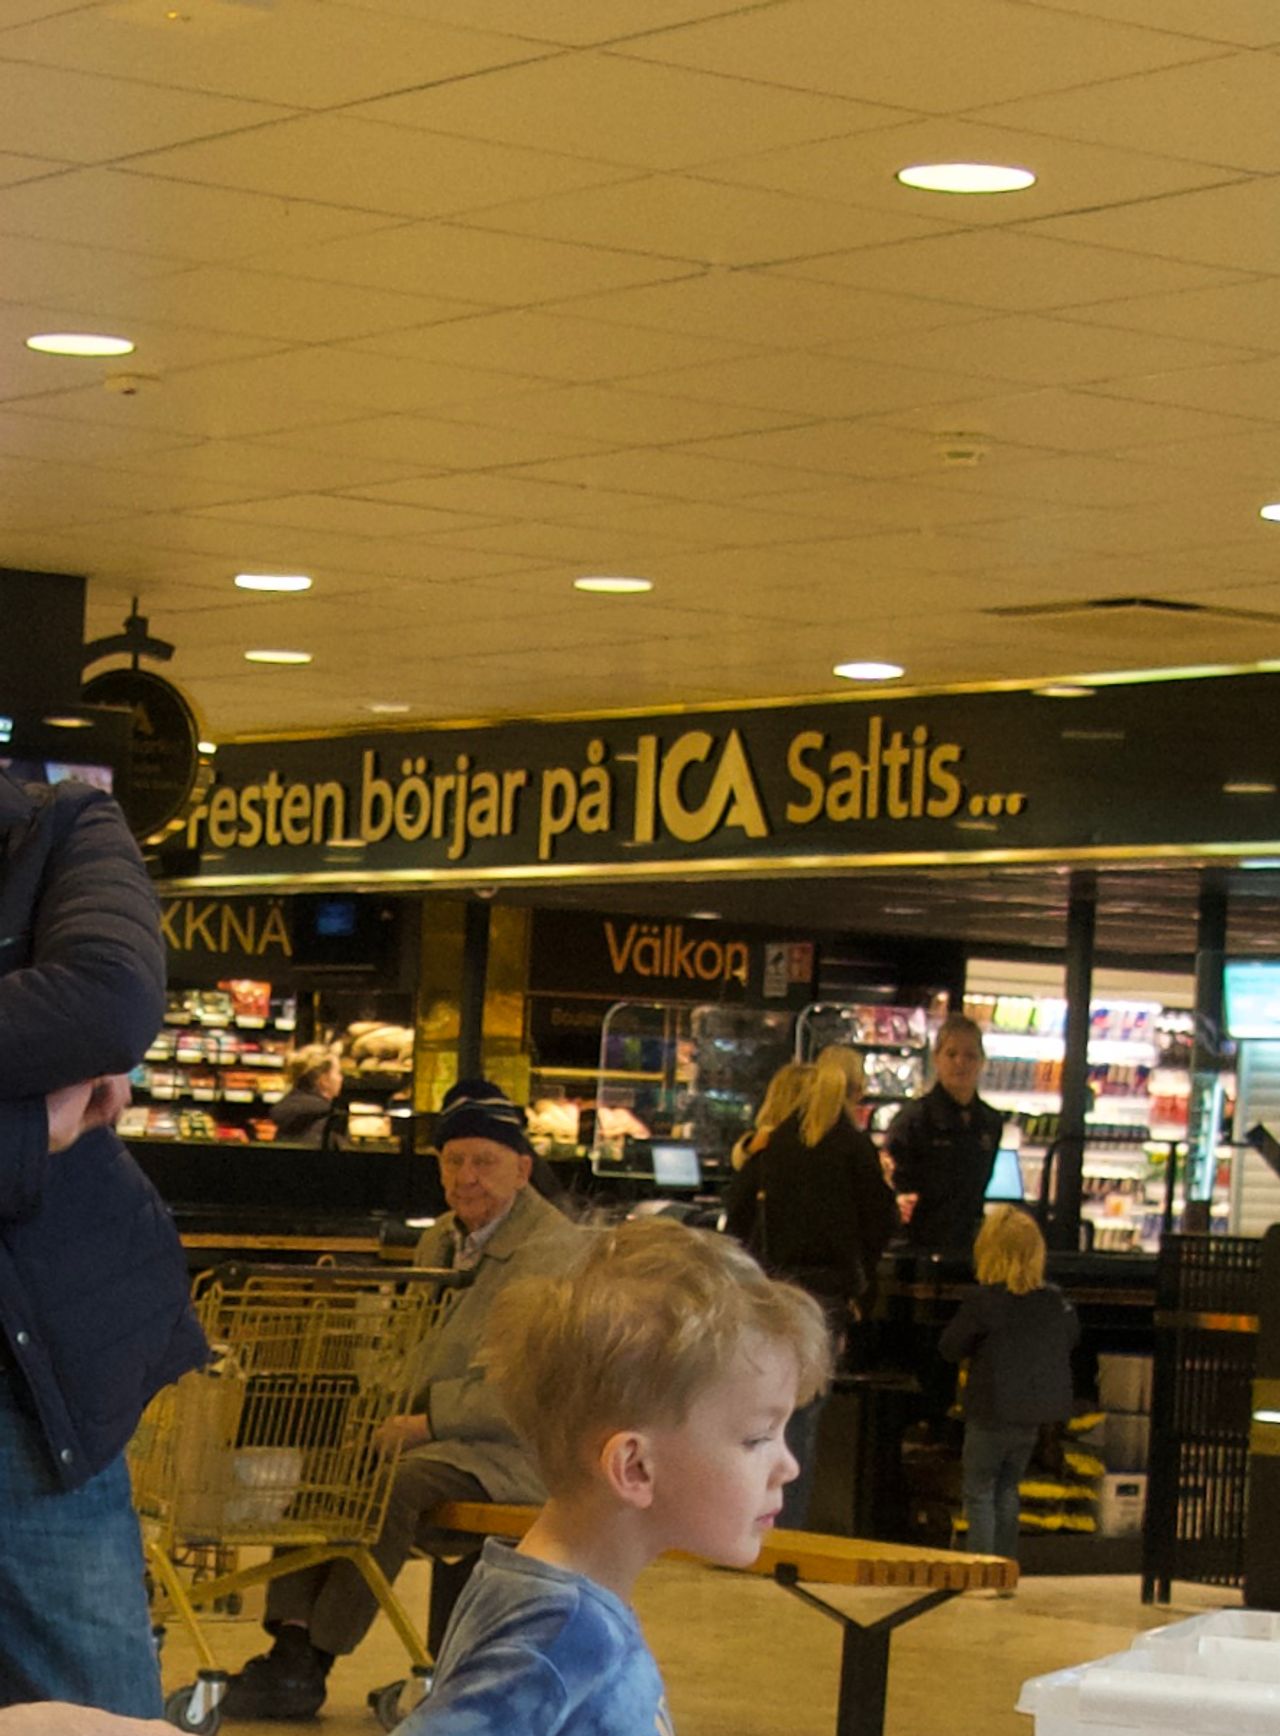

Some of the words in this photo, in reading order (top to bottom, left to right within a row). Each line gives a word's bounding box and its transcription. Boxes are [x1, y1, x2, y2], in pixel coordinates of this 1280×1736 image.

[361, 749, 527, 860] börjar
[538, 739, 611, 860] på
[634, 728, 770, 843] ICA
[786, 715, 1026, 824] Saltis...
